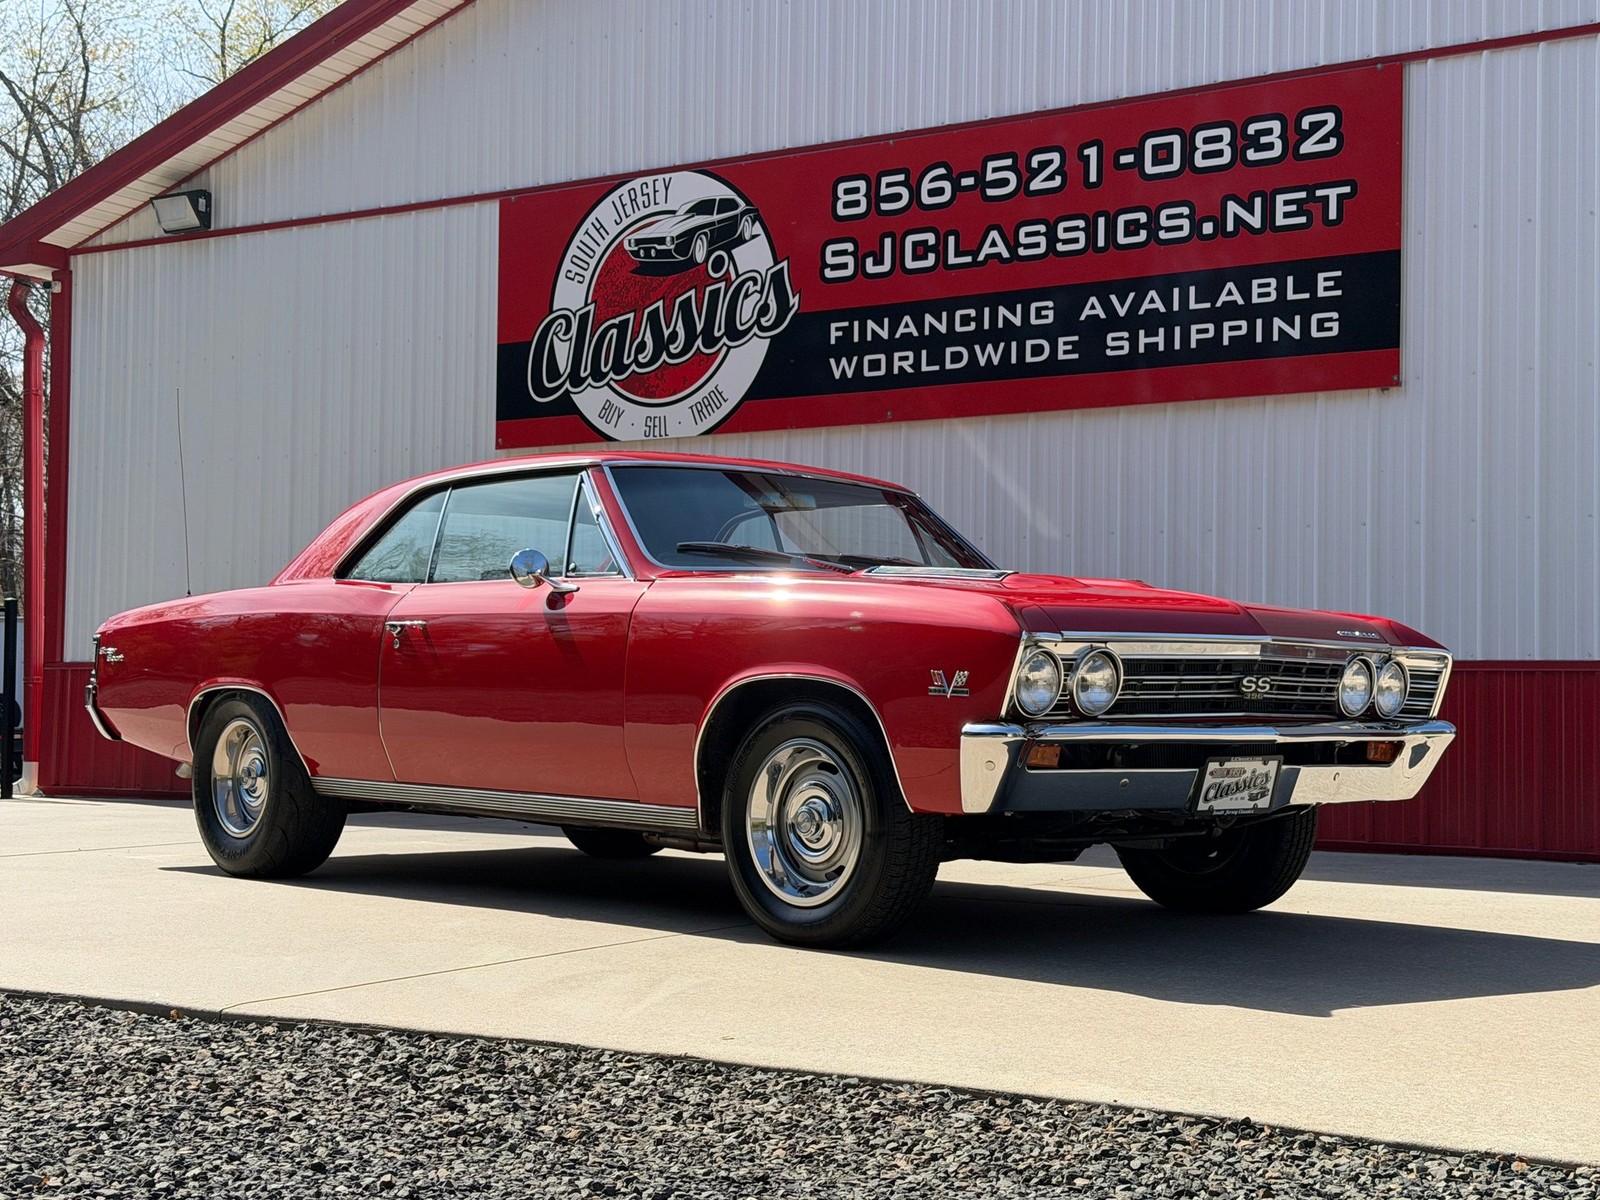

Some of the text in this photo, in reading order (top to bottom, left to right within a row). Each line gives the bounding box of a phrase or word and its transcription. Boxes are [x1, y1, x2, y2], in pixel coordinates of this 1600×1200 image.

[836, 112, 1338, 217] 856-521-0832
[565, 176, 673, 285] SOUTH JERSEY
[528, 250, 801, 402] Classics
[830, 270, 1343, 345] FINANCING AVAILABLE
[829, 311, 1340, 380] WORLDWIDE SHIPPING
[597, 383, 729, 438] BUY SELL TRADE
[1241, 676, 1271, 693] SS
[1243, 692, 1264, 700] 396
[1202, 768, 1272, 804] Classics
